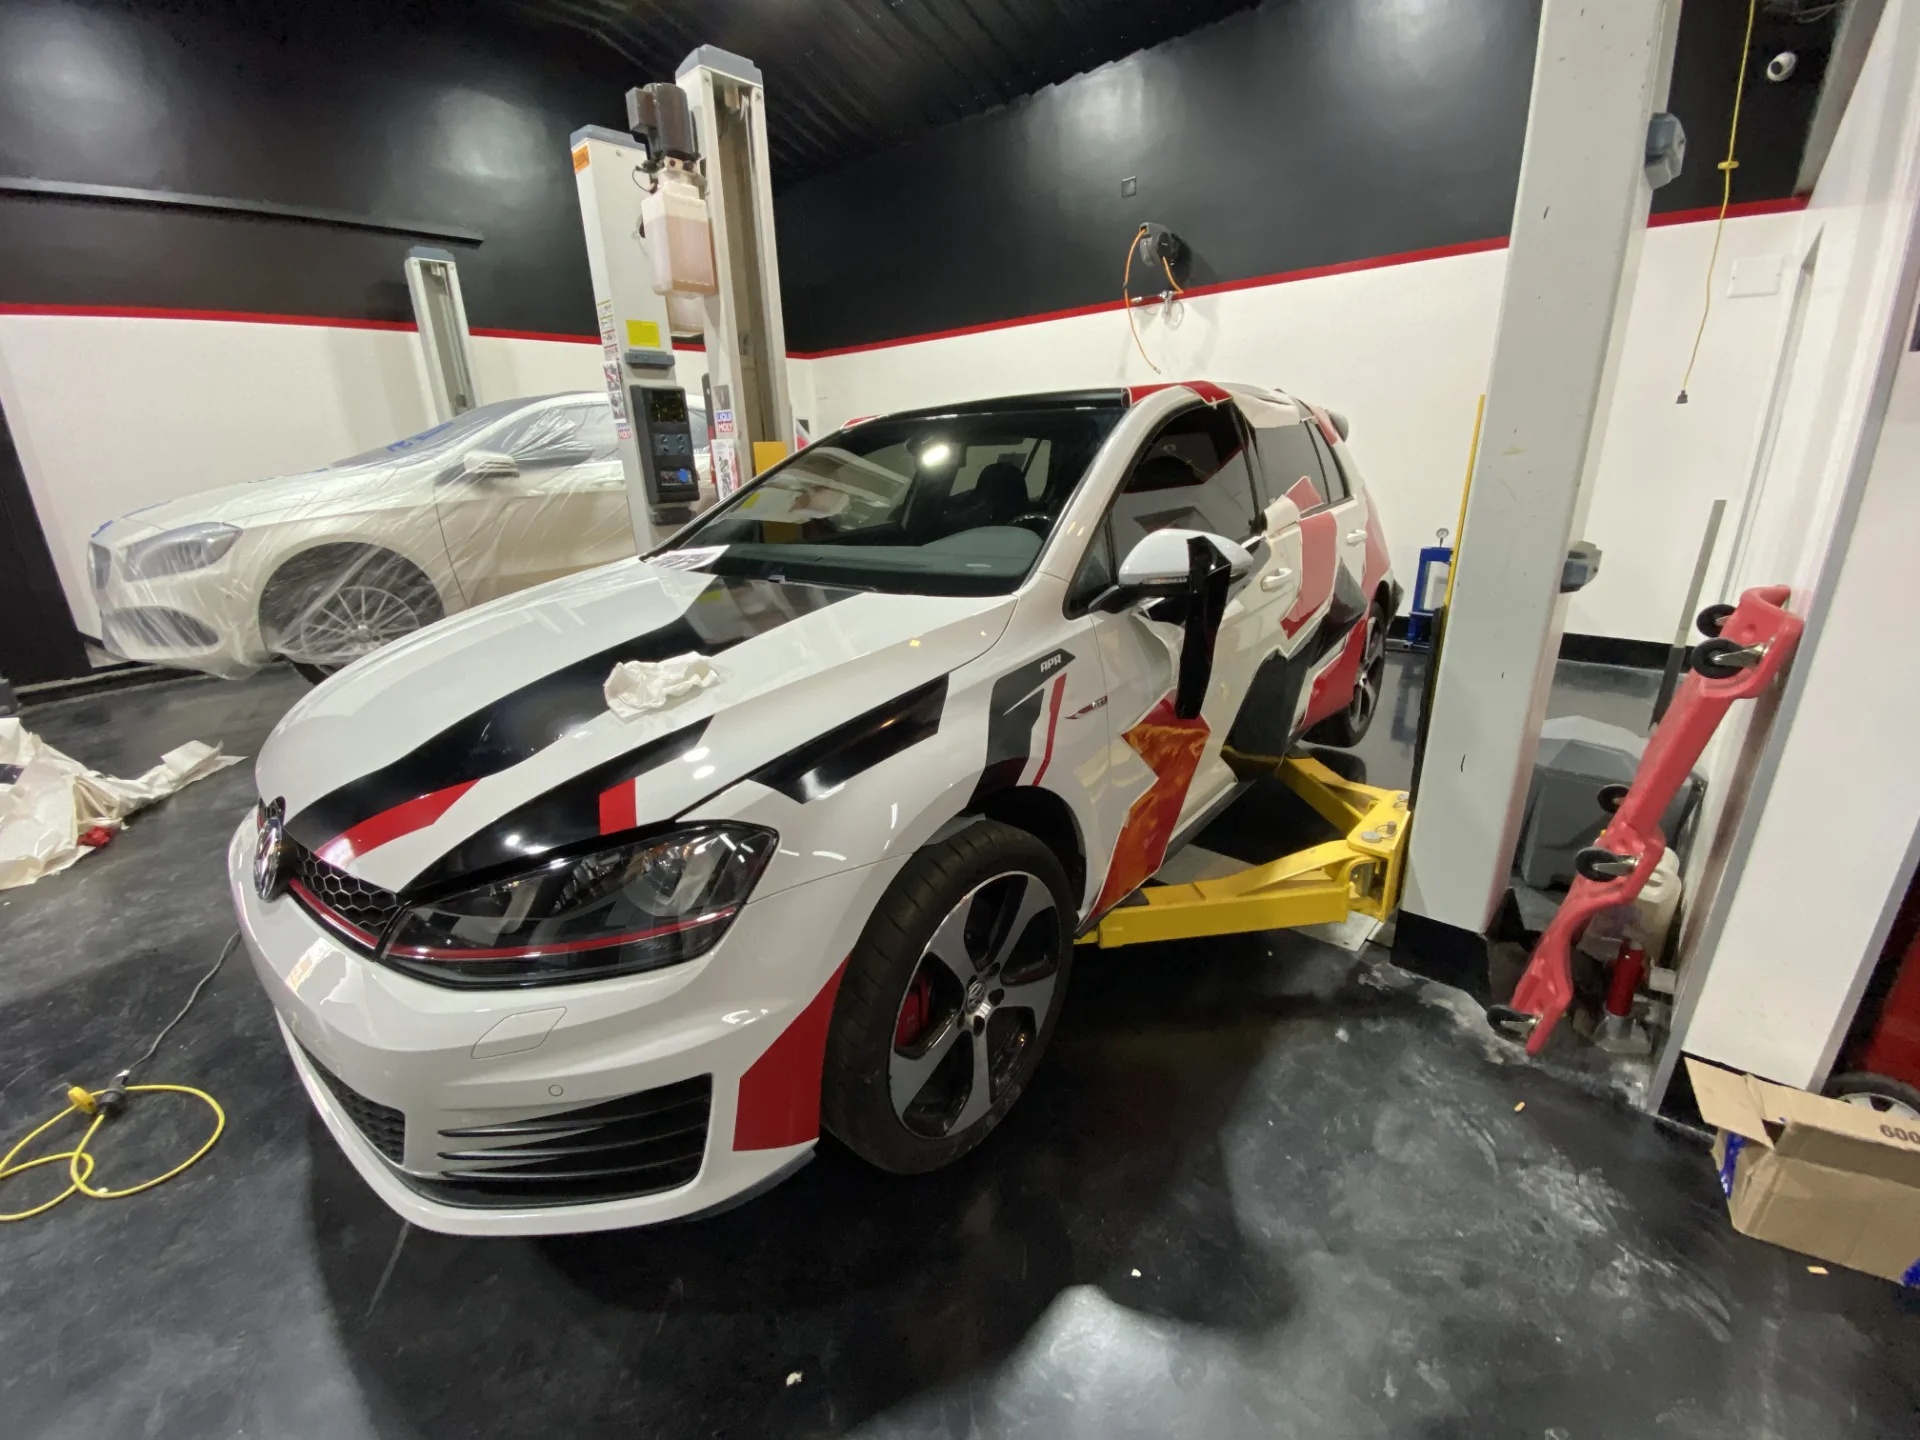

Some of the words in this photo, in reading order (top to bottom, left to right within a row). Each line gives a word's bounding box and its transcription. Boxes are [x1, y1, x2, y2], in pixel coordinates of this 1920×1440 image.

[717, 412, 732, 421] LIQUI
[718, 422, 733, 432] MOLY
[1040, 653, 1062, 672] APR
[1879, 1124, 1920, 1145] 600
